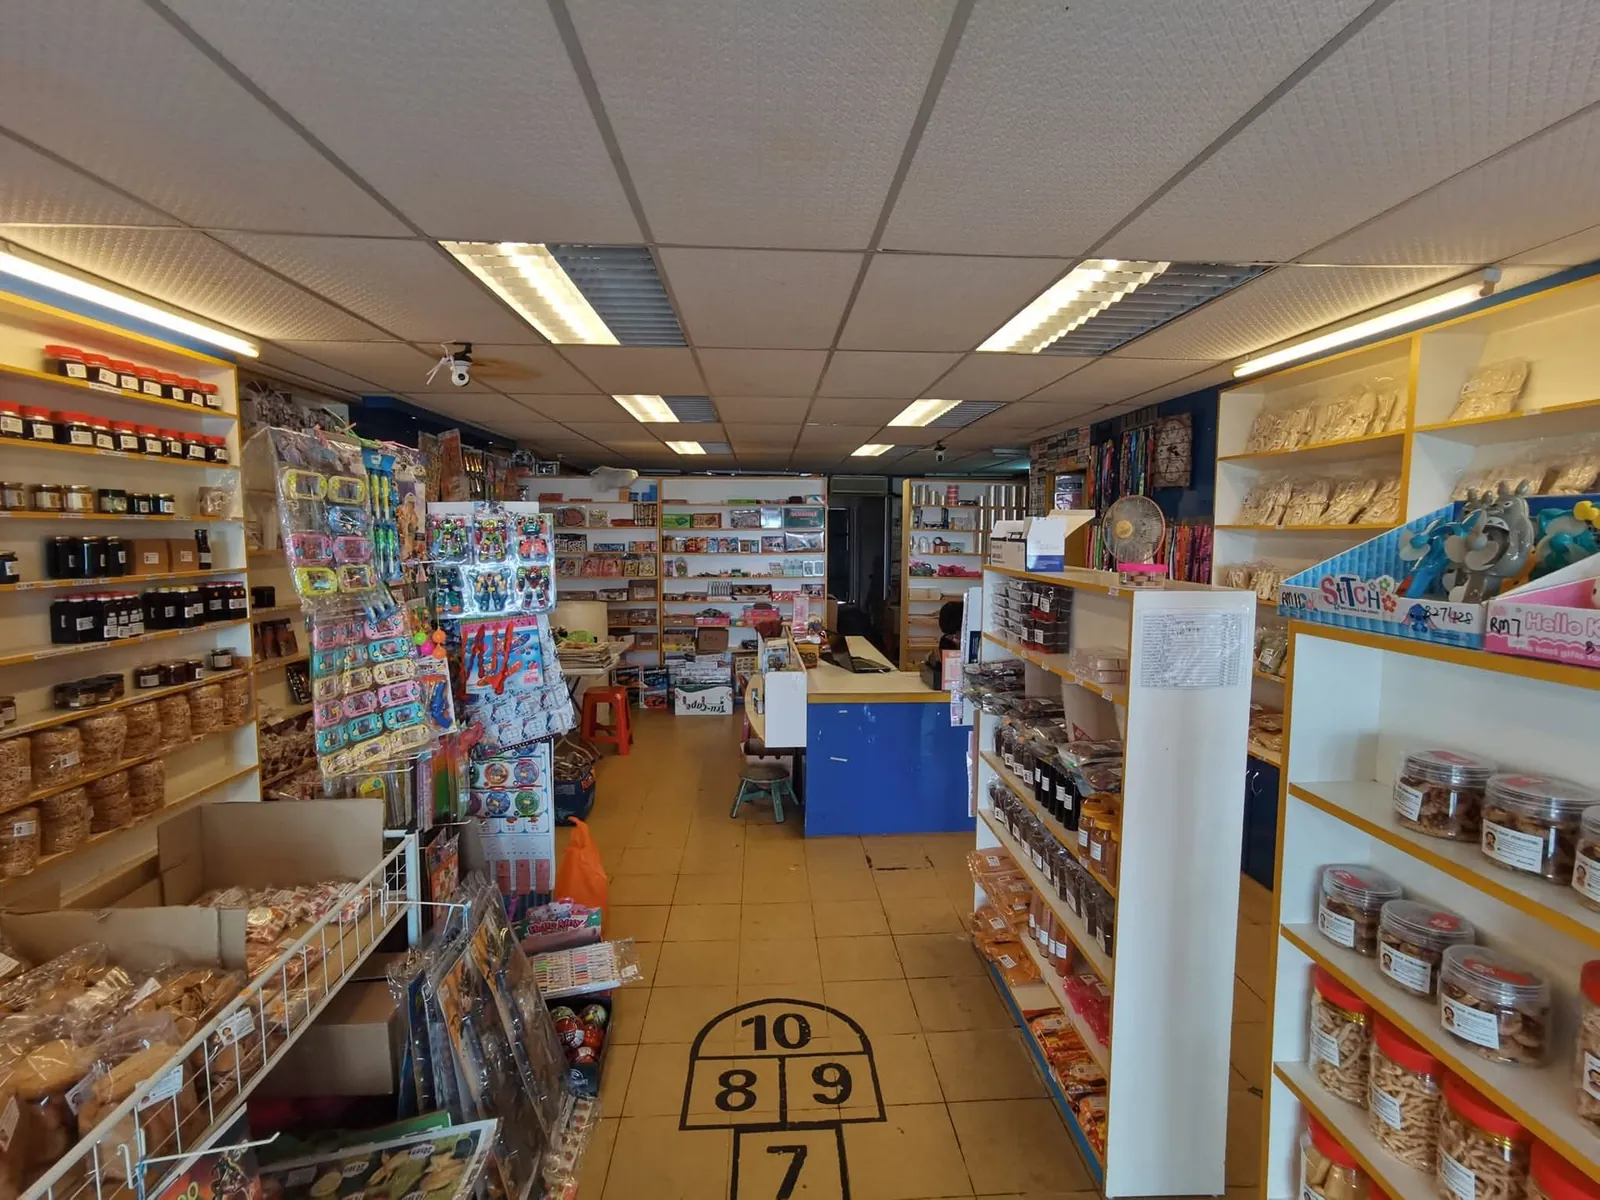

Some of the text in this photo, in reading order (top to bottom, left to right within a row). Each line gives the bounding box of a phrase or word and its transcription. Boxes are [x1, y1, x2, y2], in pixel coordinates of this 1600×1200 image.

[1525, 611, 1583, 636] Hello
[686, 700, 726, 713] Tru-Cape
[741, 1013, 812, 1051] 10
[715, 1069, 757, 1112] 8
[812, 1062, 853, 1105] 9
[766, 1144, 808, 1200] 7
